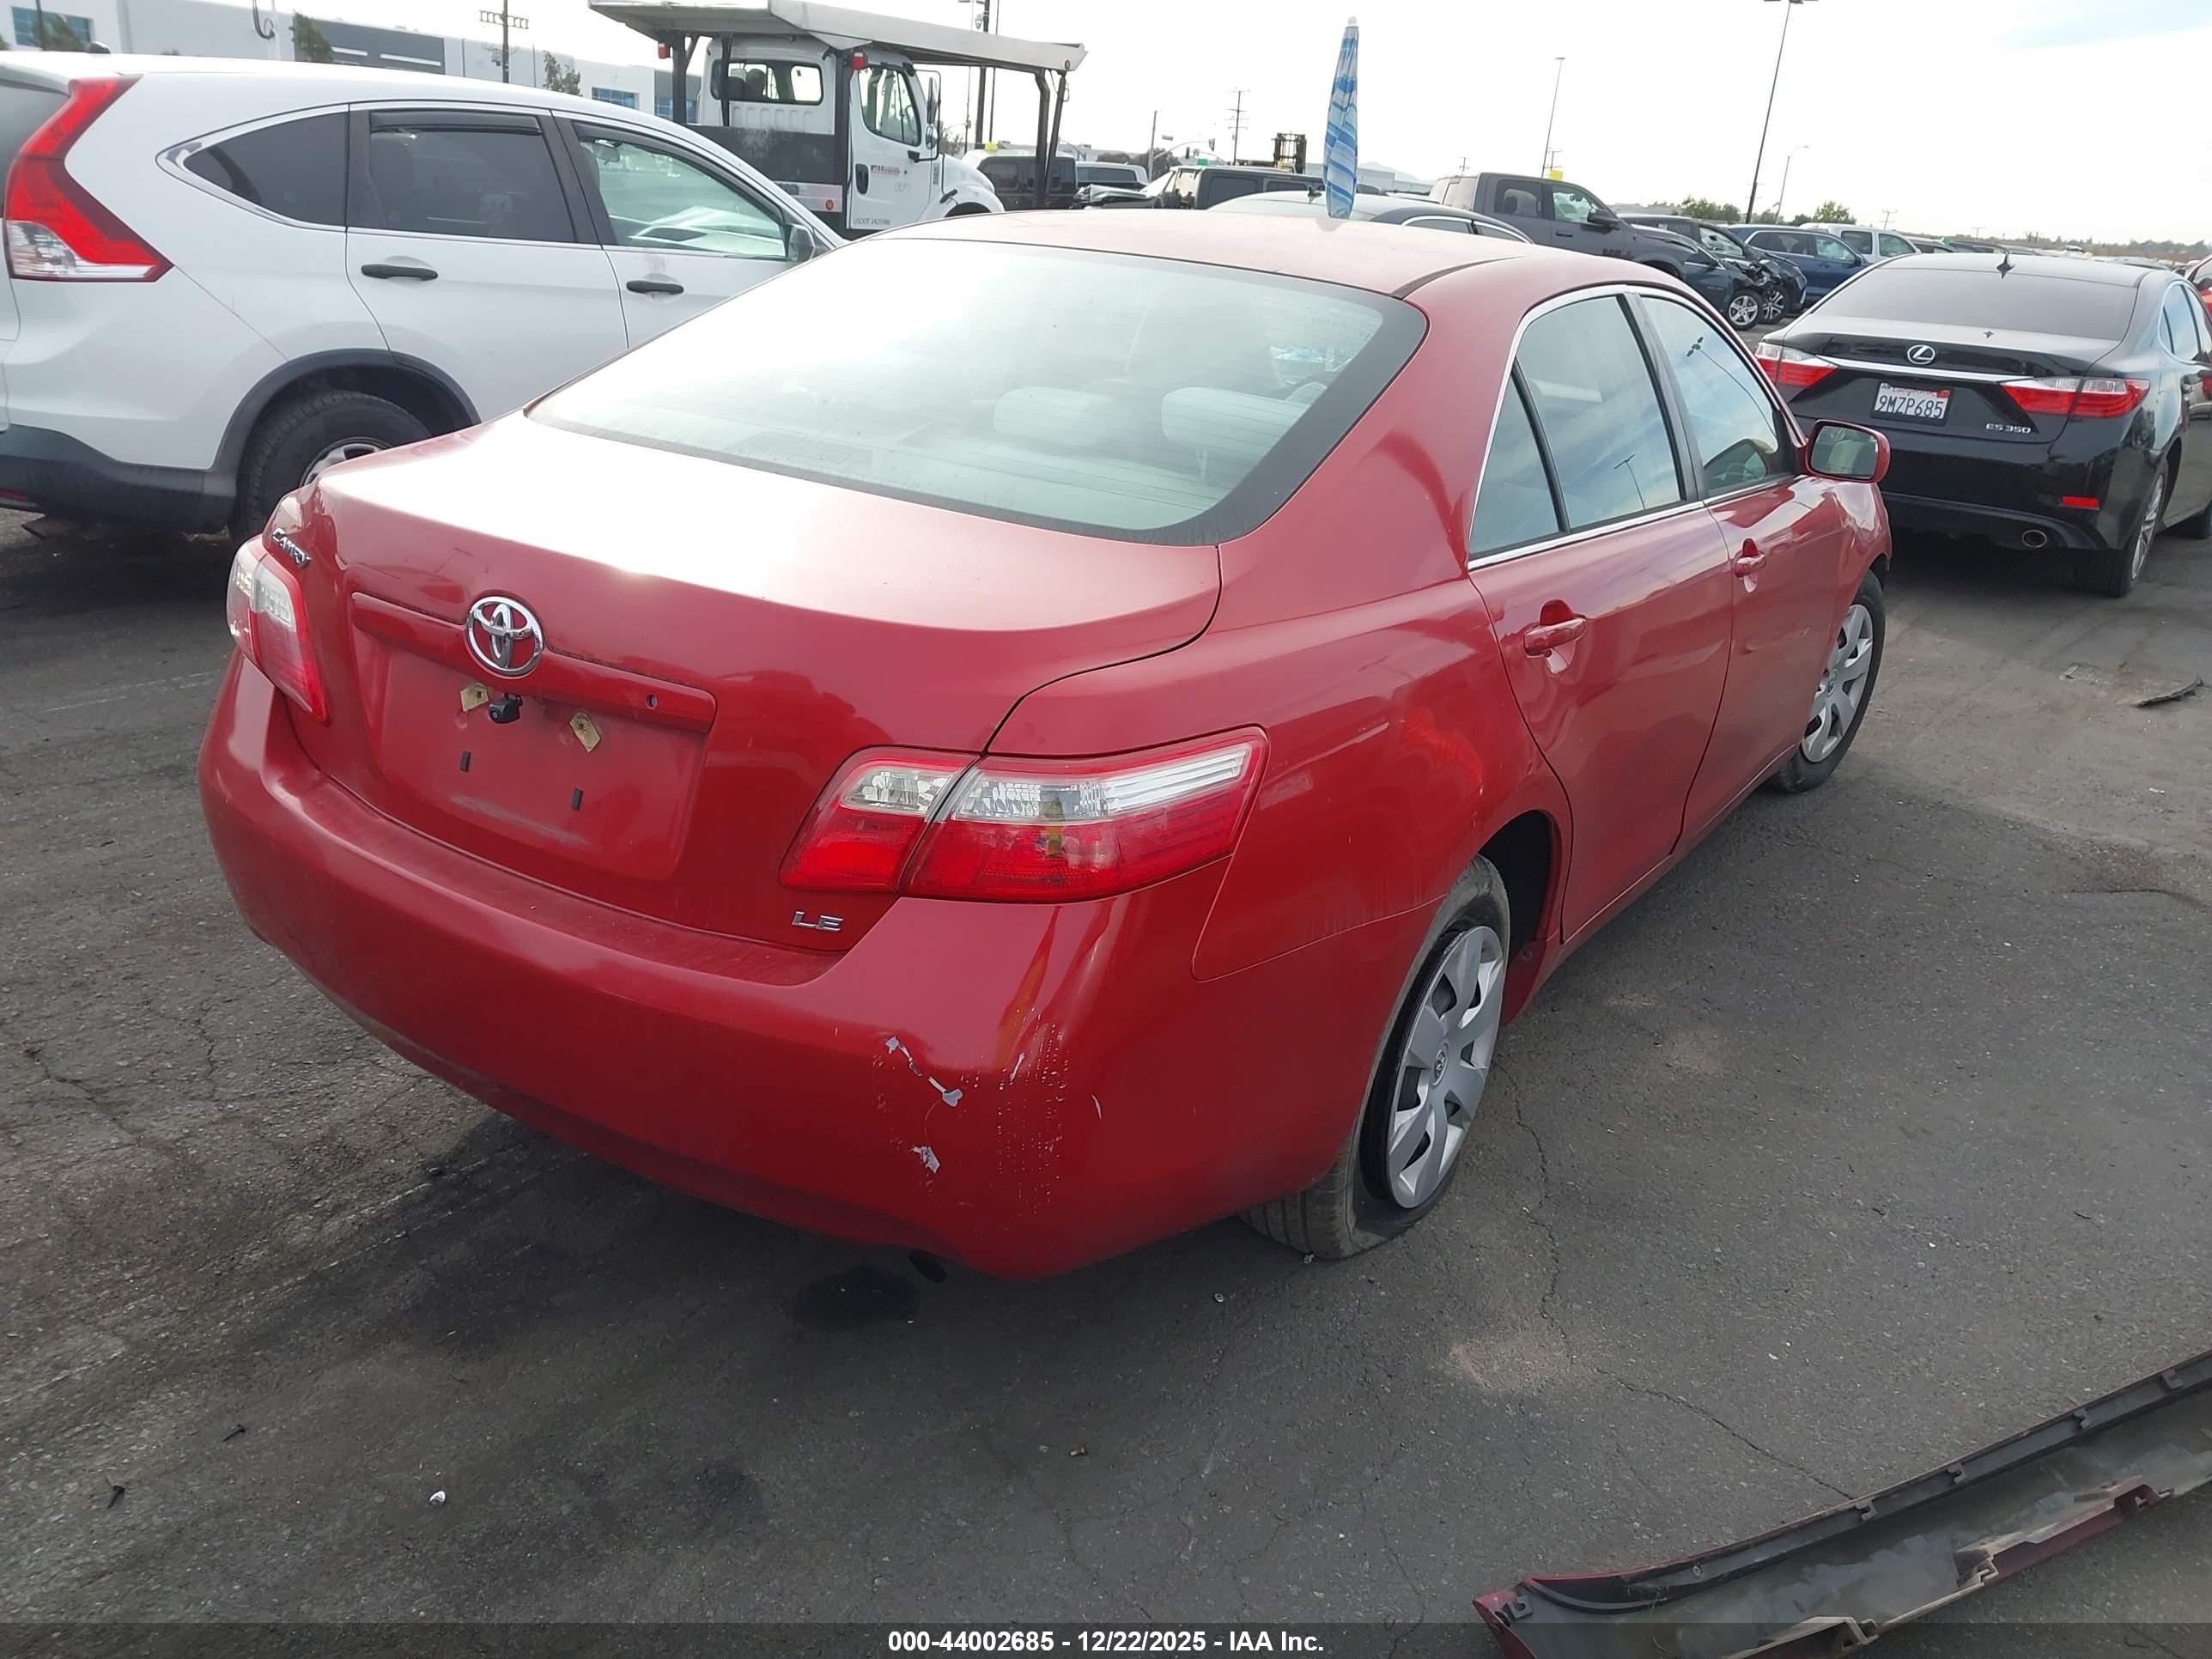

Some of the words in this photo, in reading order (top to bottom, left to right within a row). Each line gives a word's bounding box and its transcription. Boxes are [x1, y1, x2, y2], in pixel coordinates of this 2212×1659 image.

[1875, 394, 1944, 419] 9MZP685
[1985, 422, 2003, 431] ES
[2005, 424, 2032, 434] 350
[791, 910, 844, 932] LE
